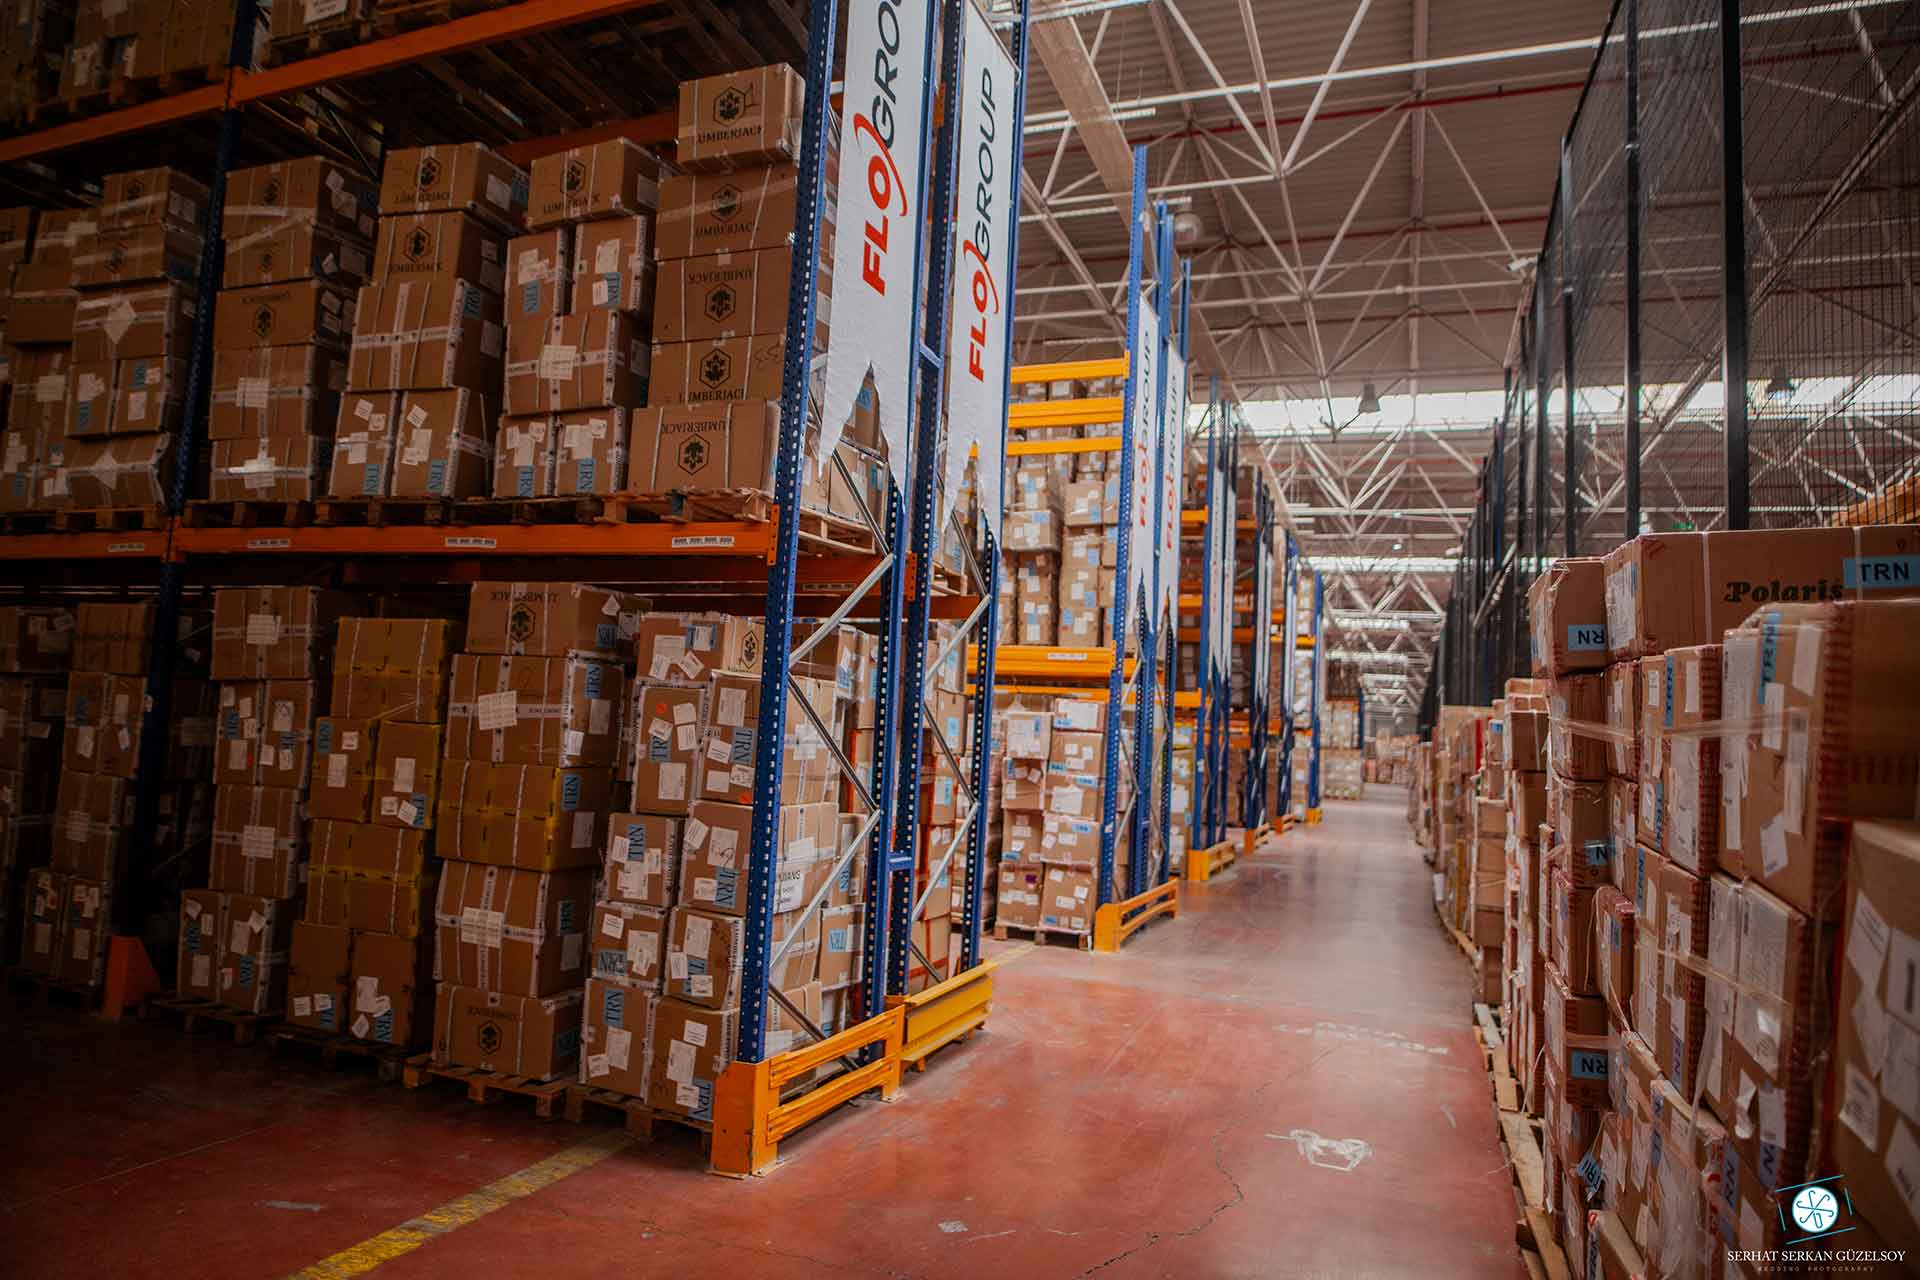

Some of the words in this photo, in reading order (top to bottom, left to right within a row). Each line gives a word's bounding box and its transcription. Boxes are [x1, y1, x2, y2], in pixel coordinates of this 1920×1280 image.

[872, 0, 900, 149] GRO
[975, 67, 995, 262] GROUP
[1859, 561, 1910, 582] TRN
[1724, 578, 1844, 603] Polaris
[1577, 629, 1605, 645] RN
[606, 991, 624, 1024] TRN
[1582, 1056, 1608, 1074] RN
